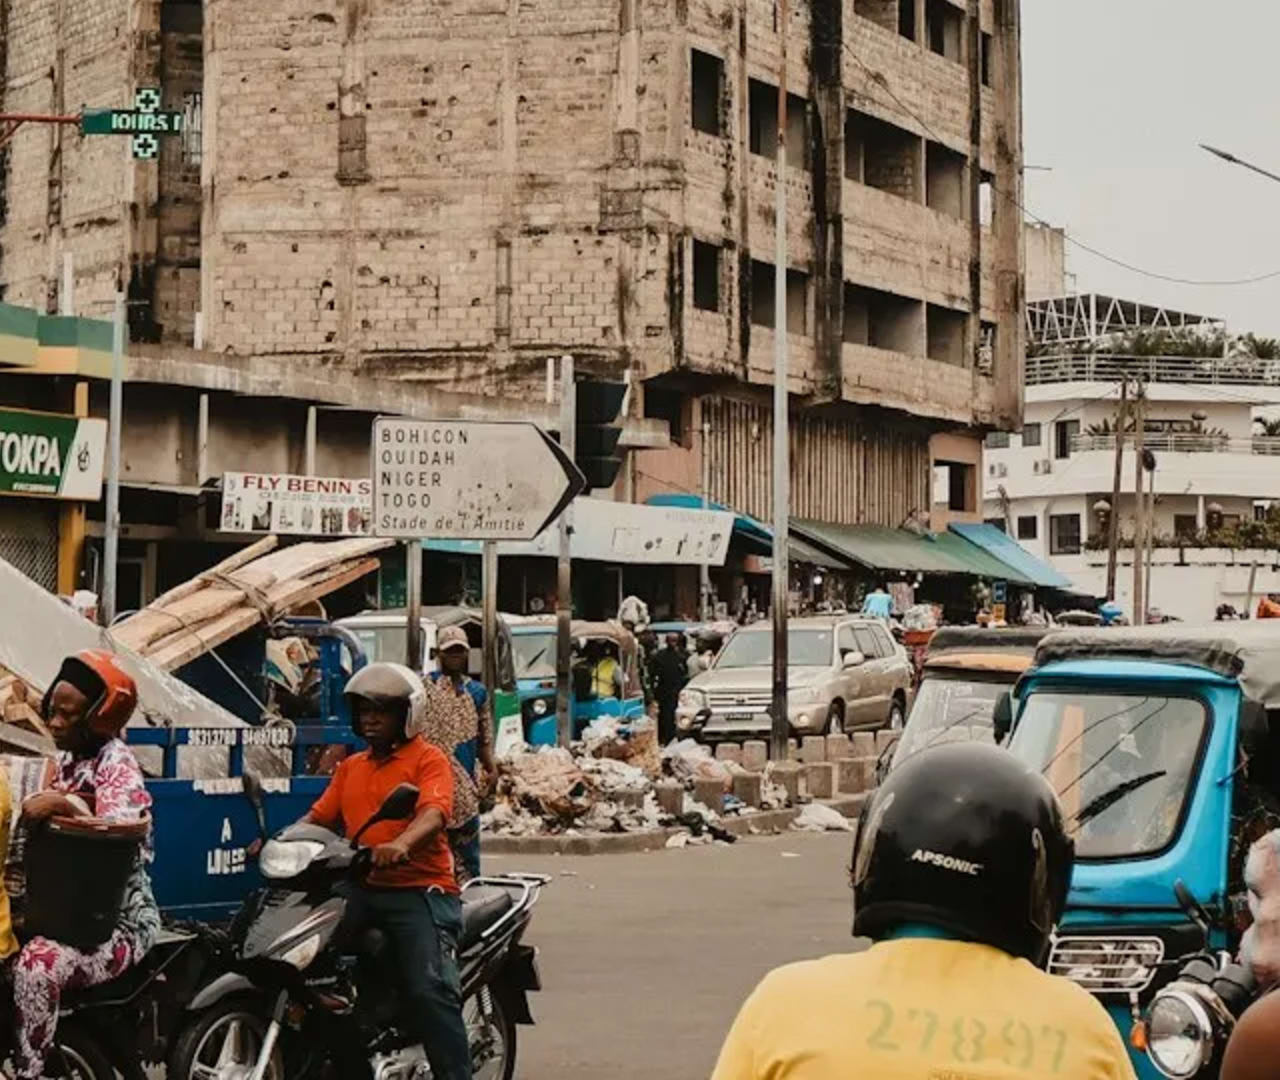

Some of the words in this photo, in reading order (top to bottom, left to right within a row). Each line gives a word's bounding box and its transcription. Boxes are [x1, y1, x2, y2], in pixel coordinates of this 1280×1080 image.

[381, 428, 468, 445] BOHICON
[381, 450, 455, 466] OUIDAH
[243, 475, 281, 490] FLY
[287, 477, 352, 494] BENIN
[357, 480, 371, 495] S
[381, 471, 442, 487] NIGER
[381, 493, 432, 509] TOGO
[381, 516, 428, 531] Stade
[434, 516, 454, 531] de
[220, 817, 233, 843] A
[911, 849, 980, 875] APSONIC
[864, 998, 1069, 1074] 27897
